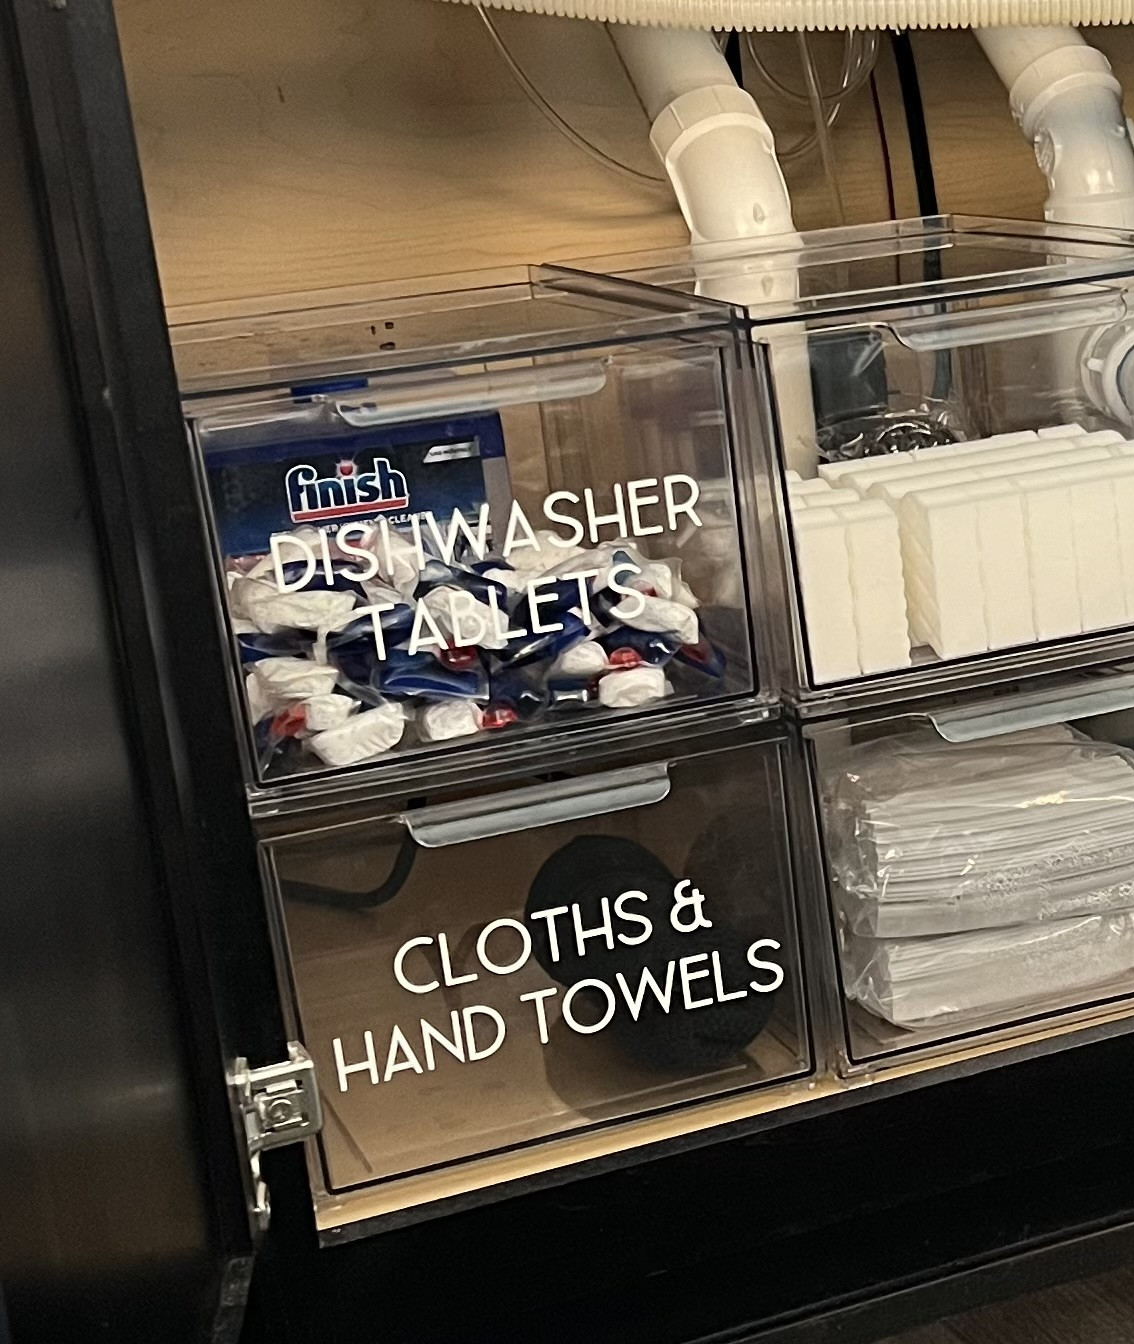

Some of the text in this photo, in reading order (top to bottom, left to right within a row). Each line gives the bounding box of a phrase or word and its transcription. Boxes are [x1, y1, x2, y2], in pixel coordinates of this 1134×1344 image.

[269, 474, 703, 594] DISHWASHER
[286, 457, 409, 514] finish
[358, 562, 647, 661] TABLETS
[393, 879, 713, 995] CLOTHS &
[332, 939, 785, 1093] HAND TOWELS
